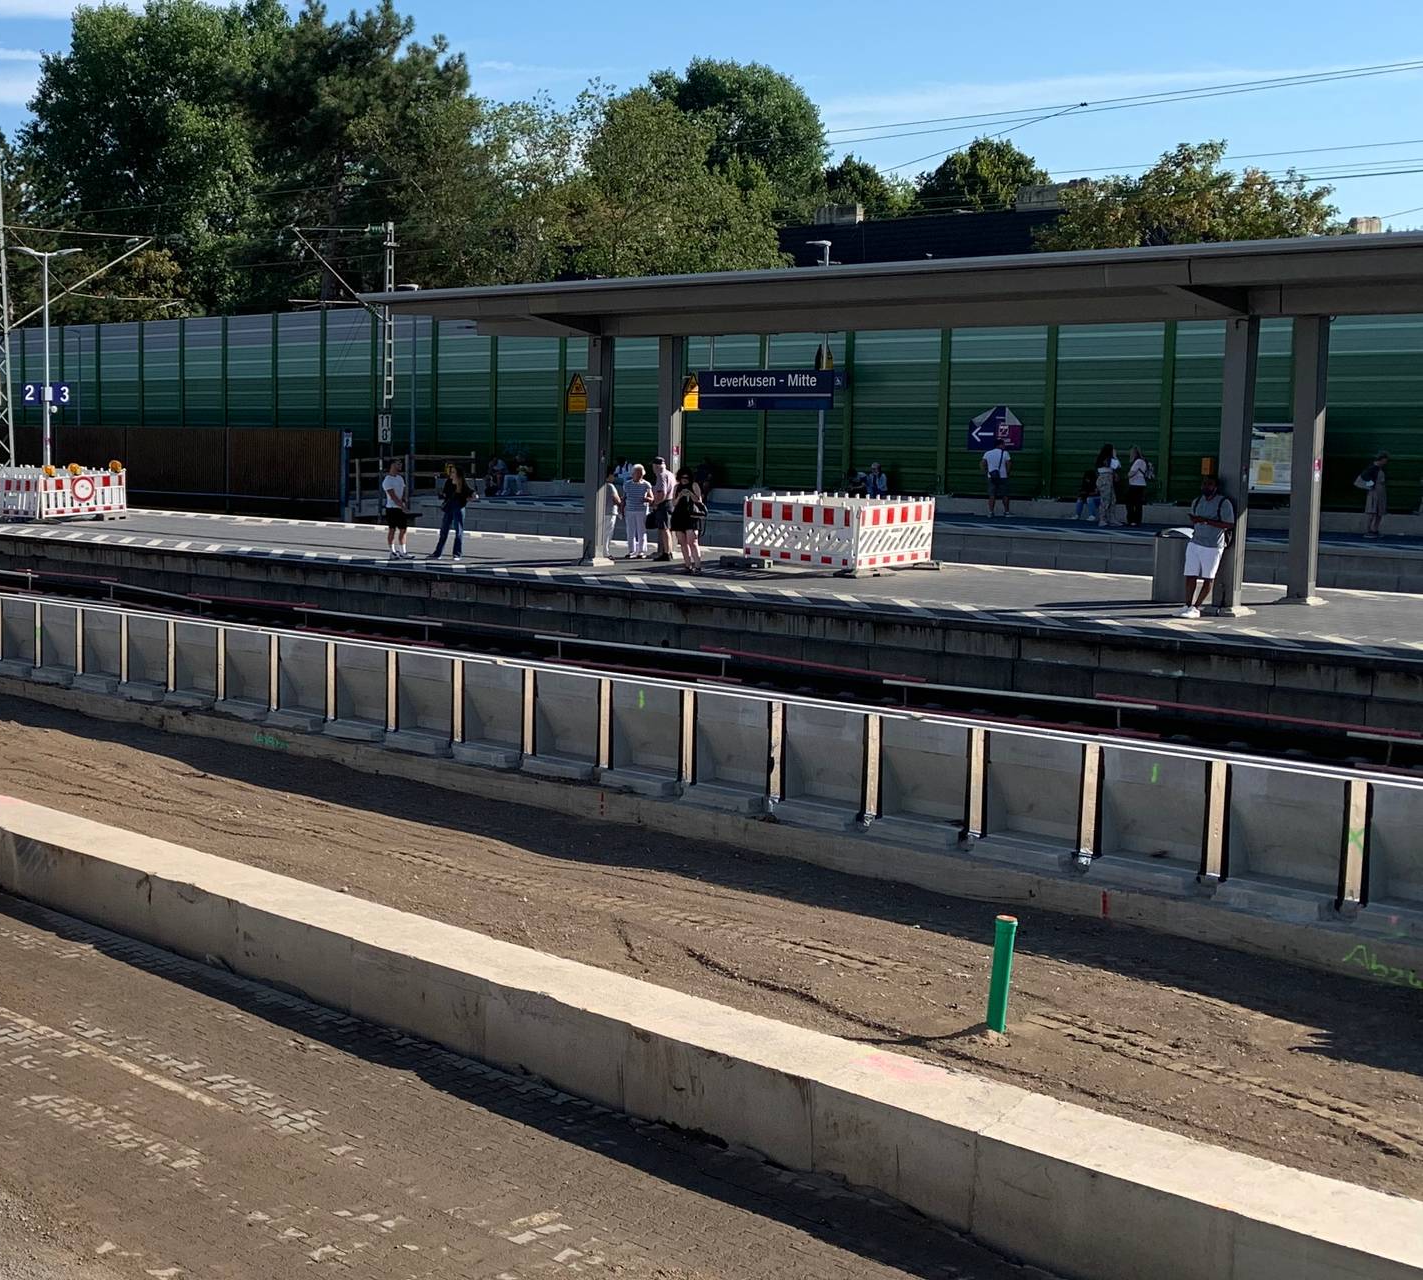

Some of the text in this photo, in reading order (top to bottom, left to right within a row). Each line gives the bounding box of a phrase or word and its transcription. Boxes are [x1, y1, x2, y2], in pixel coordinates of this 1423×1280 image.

[713, 374, 776, 387] Leverkusen
[787, 373, 817, 387] Mitte
[24, 384, 70, 402] 2 3
